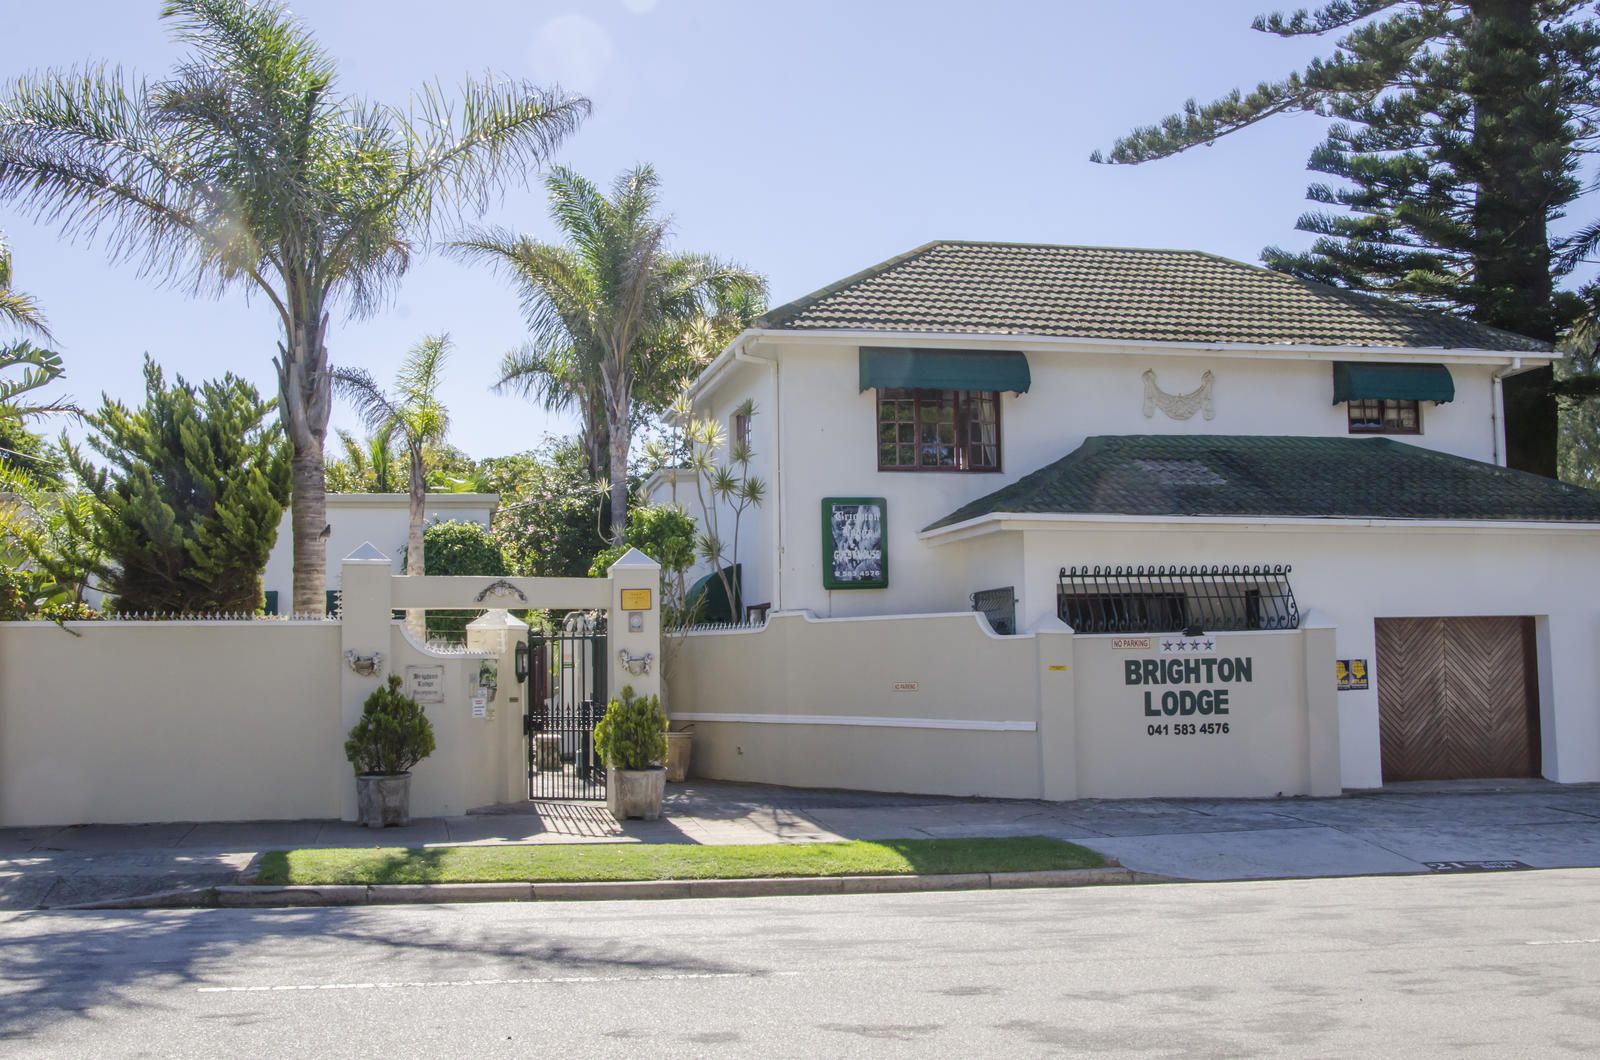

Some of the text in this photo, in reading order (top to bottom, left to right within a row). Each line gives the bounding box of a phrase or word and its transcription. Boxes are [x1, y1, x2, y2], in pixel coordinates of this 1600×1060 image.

[1113, 639, 1148, 648] NO PARKING
[1124, 657, 1253, 685] BRIGHTON
[1144, 689, 1230, 717] LODGE
[1147, 722, 1230, 736] 041 583 4576
